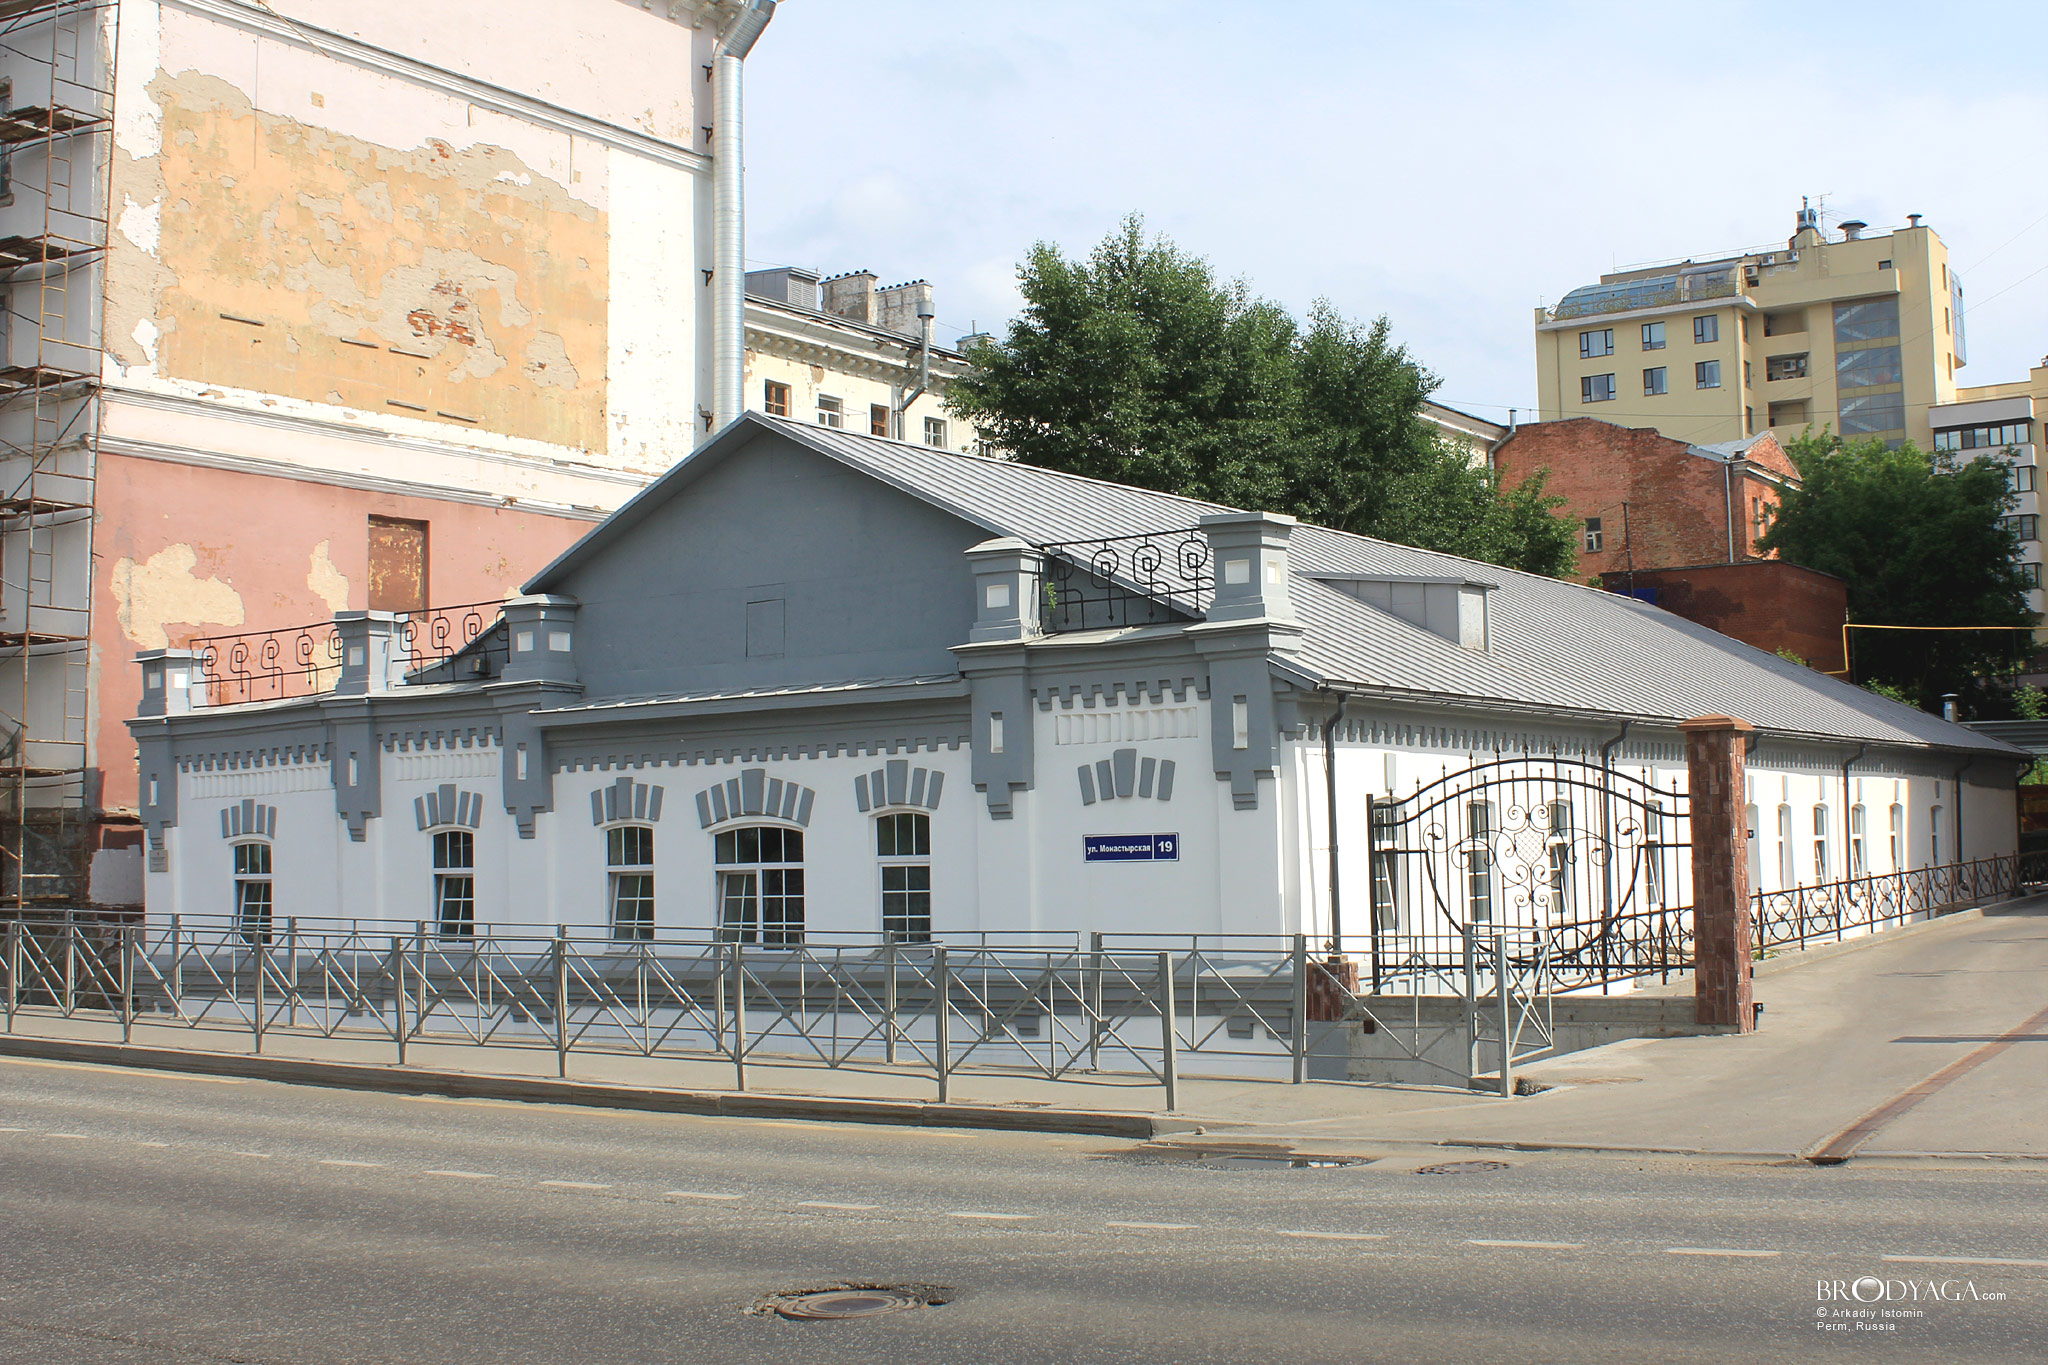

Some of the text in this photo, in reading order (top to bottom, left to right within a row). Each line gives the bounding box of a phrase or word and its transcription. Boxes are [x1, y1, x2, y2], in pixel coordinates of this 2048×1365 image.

[1087, 841, 1173, 855] ул. Монастырская 19
